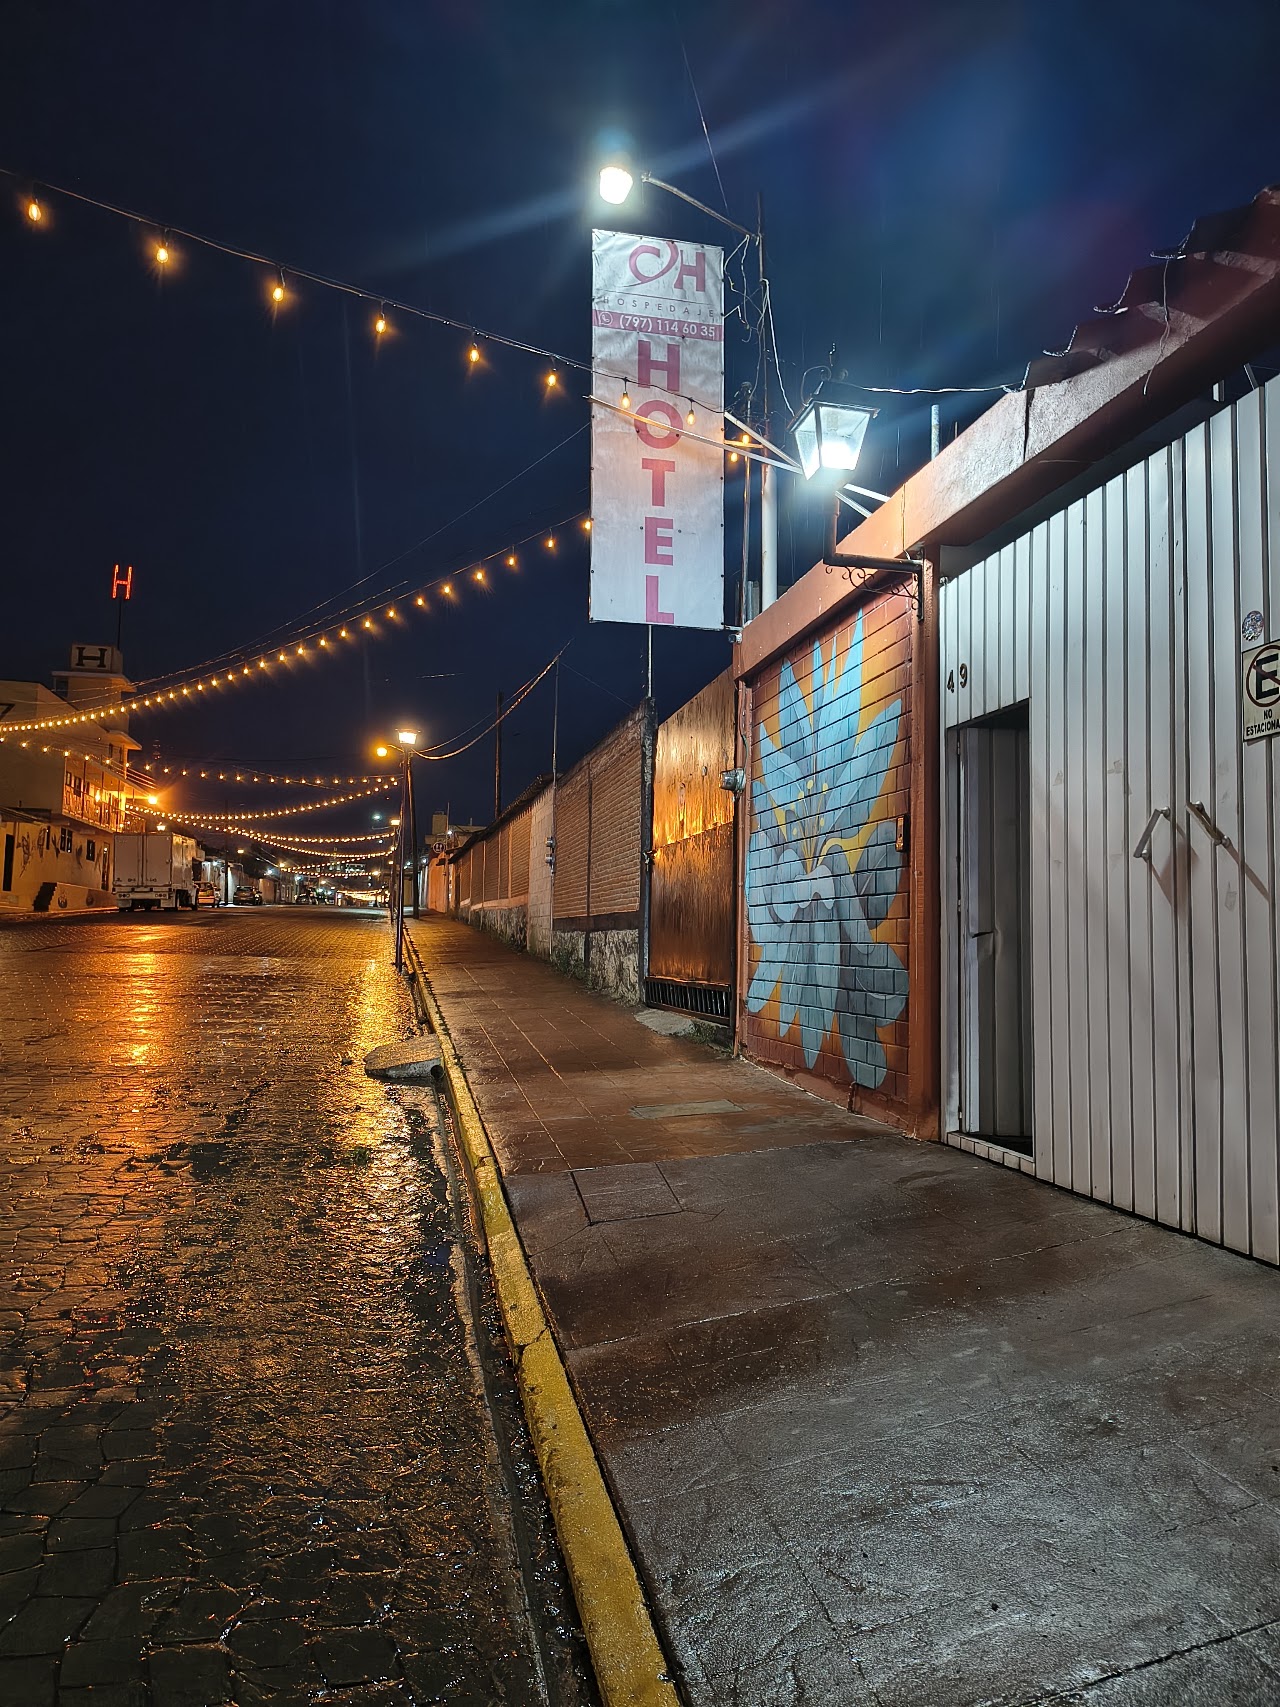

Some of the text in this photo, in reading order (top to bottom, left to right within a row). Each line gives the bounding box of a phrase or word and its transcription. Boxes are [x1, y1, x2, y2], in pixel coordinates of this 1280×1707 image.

[602, 296, 714, 318] HOSPEDAJE
[619, 314, 715, 337] (797) 114 60 35
[634, 340, 684, 624] HOTEL
[112, 564, 133, 600] H
[75, 646, 108, 668] H
[947, 663, 968, 693] 49
[1256, 653, 1280, 700] E
[1263, 708, 1273, 720] NO
